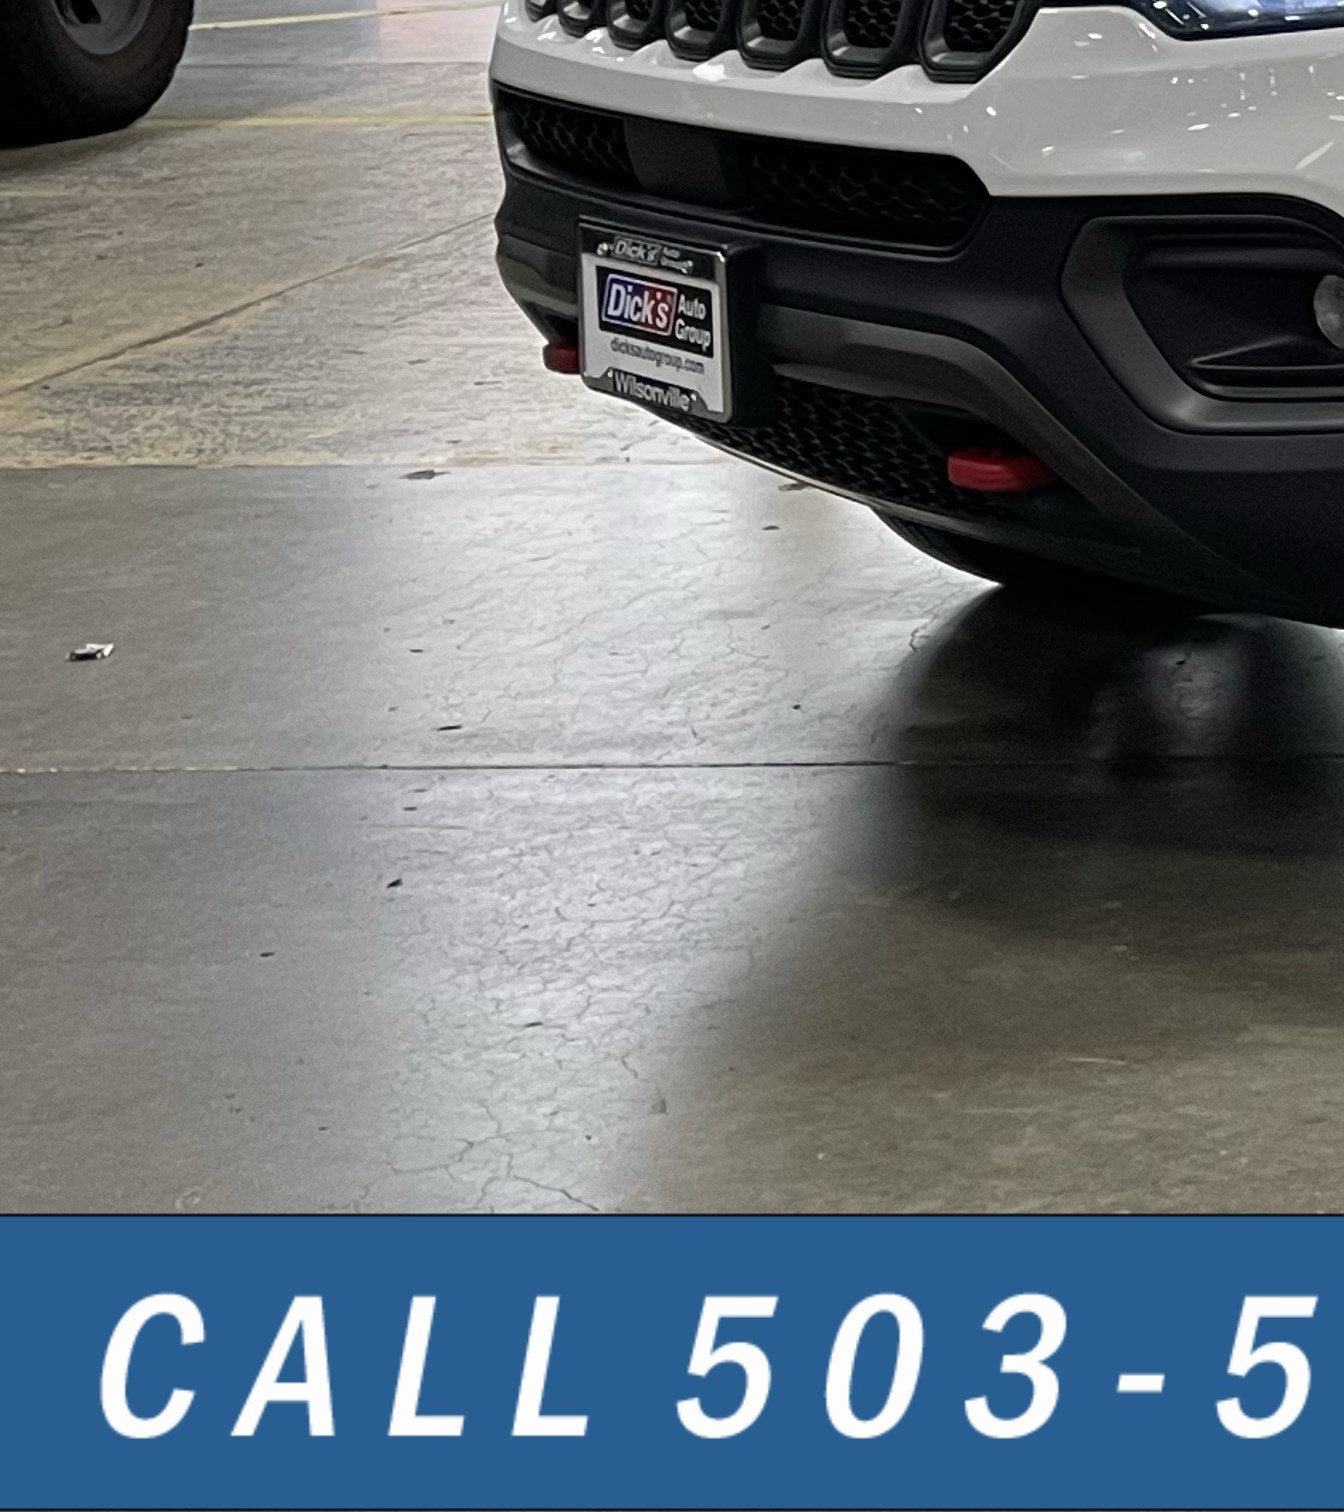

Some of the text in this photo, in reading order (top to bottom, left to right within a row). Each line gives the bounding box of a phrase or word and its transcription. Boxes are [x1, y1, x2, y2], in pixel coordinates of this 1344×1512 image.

[606, 283, 670, 329] Dick's
[677, 293, 707, 320] Auto
[675, 318, 711, 352] Group
[614, 370, 691, 412] Wilsonville
